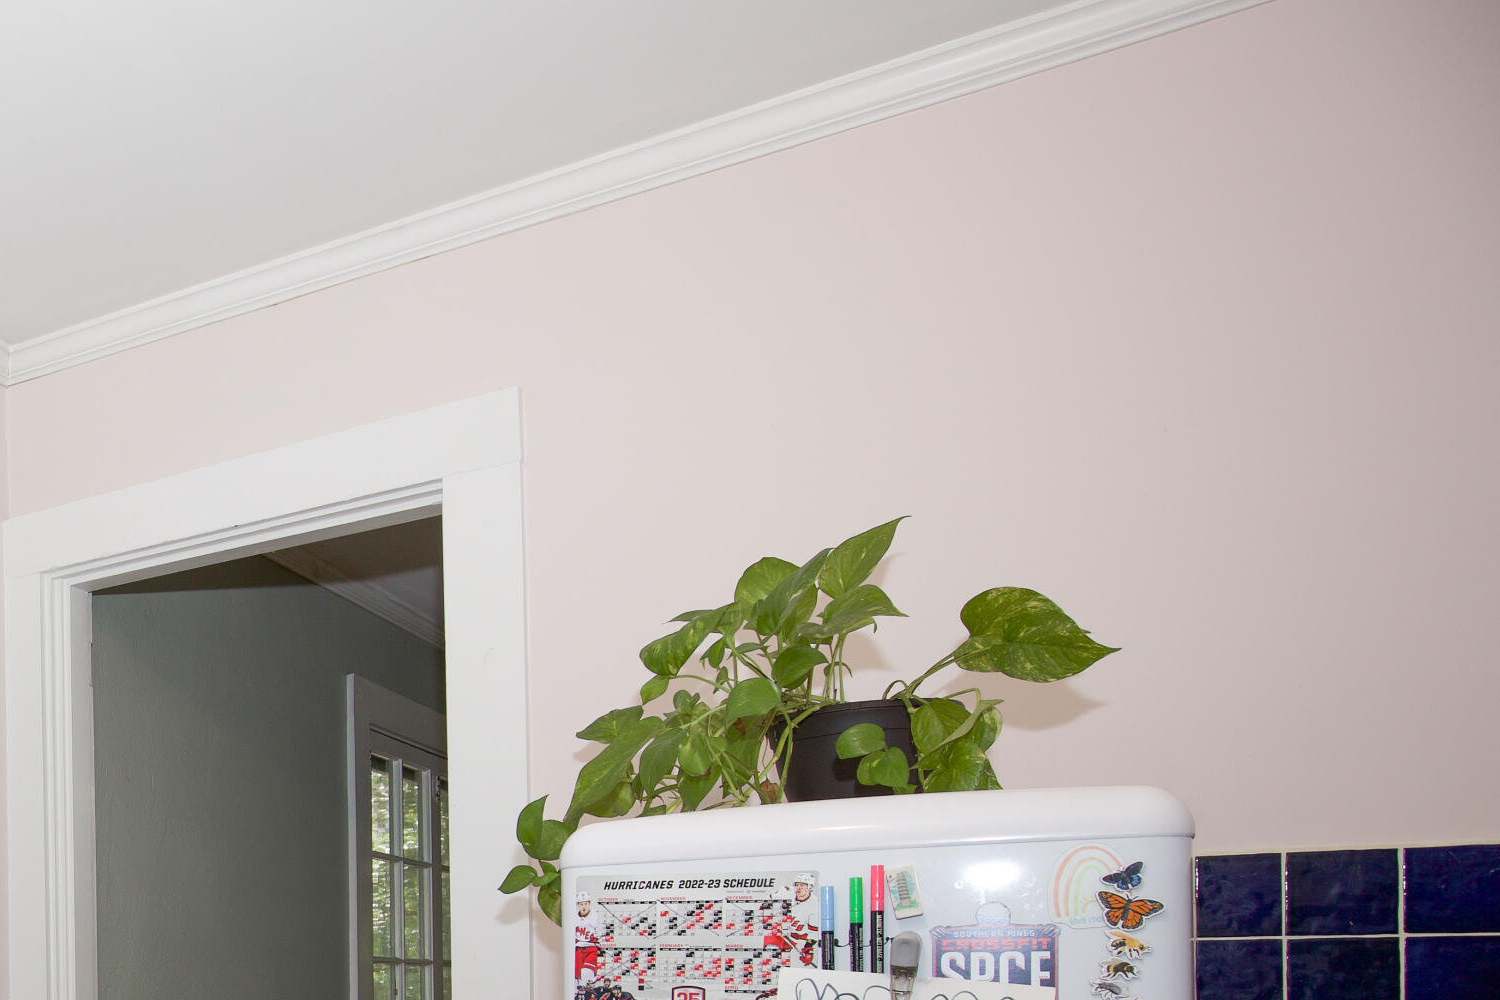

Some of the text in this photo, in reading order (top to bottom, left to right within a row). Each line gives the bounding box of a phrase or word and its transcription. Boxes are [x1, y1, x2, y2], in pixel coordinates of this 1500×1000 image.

[603, 877, 776, 891] HURRICANES 2022-23 SCHEDULE
[953, 928, 1035, 937] SOUTHERN PINES
[941, 938, 1051, 951] CROSSFIT
